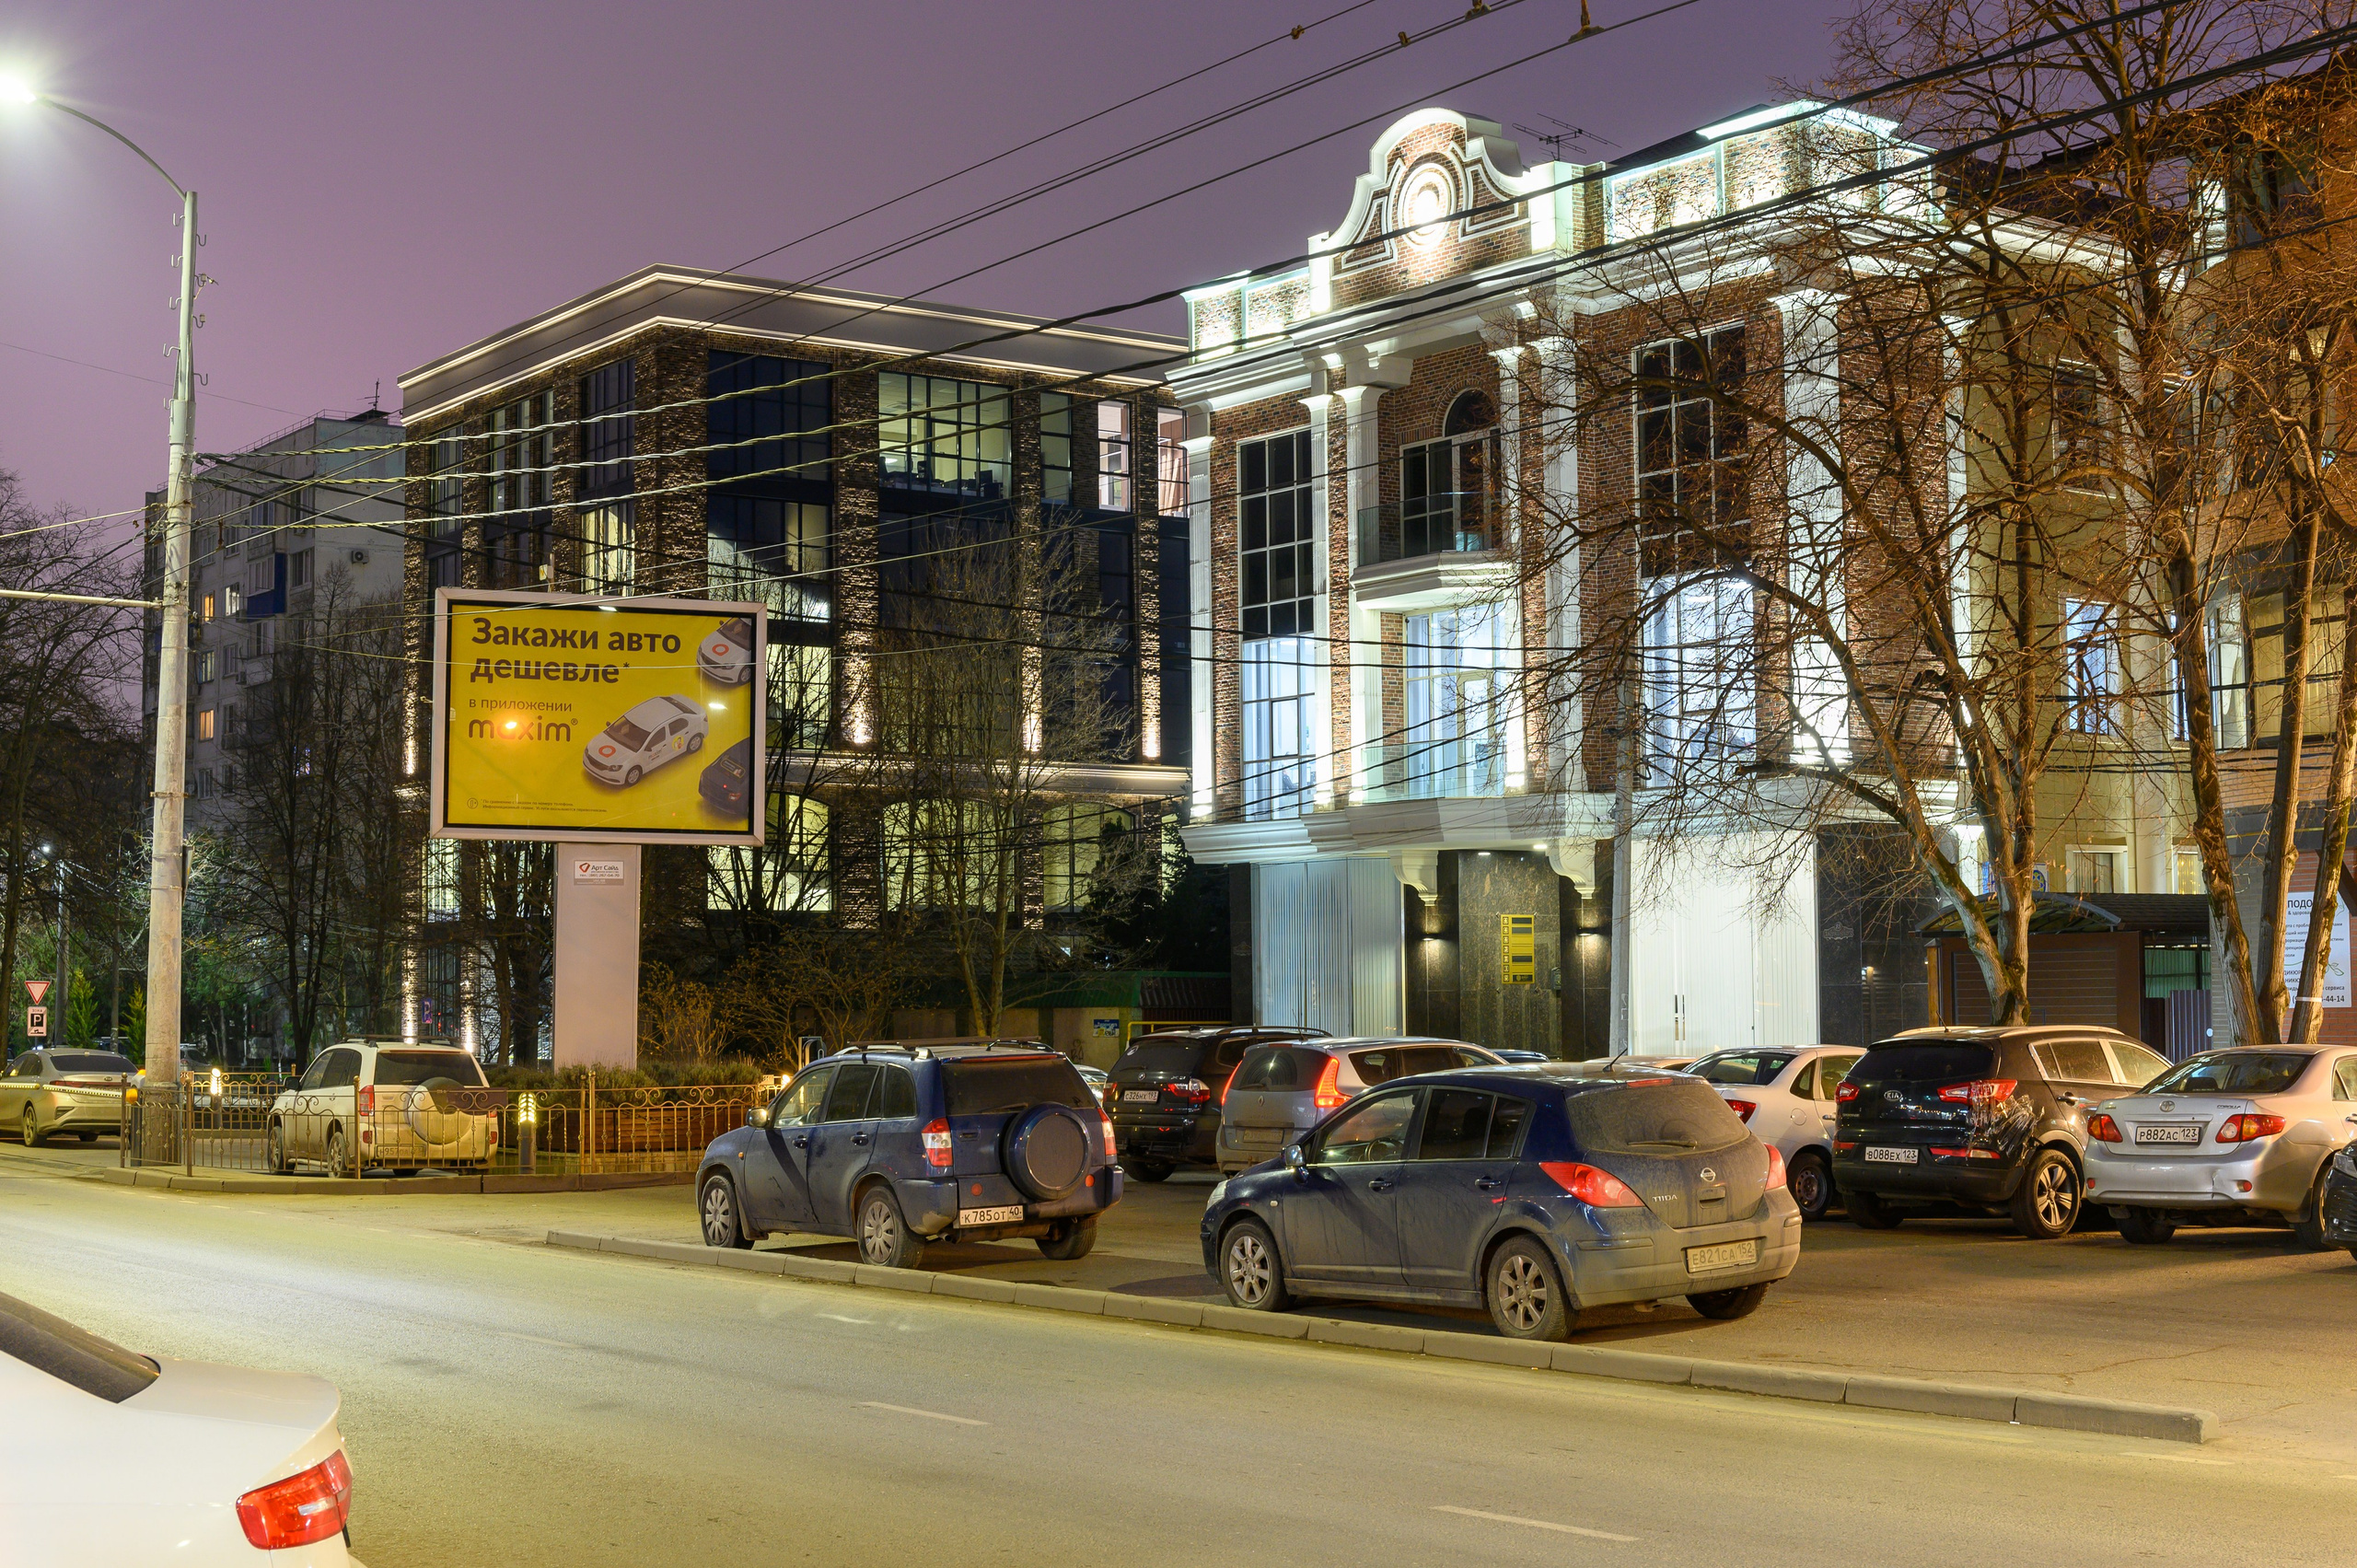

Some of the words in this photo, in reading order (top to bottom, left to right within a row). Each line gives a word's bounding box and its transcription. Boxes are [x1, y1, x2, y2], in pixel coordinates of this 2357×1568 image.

[471, 617, 598, 650] Закажи
[608, 631, 681, 654] авто
[469, 698, 477, 708] в
[481, 698, 572, 713] приложении
[2288, 899, 2313, 909] ПОДО
[33, 1014, 41, 1026] P
[1653, 1194, 1678, 1202] TIIDA
